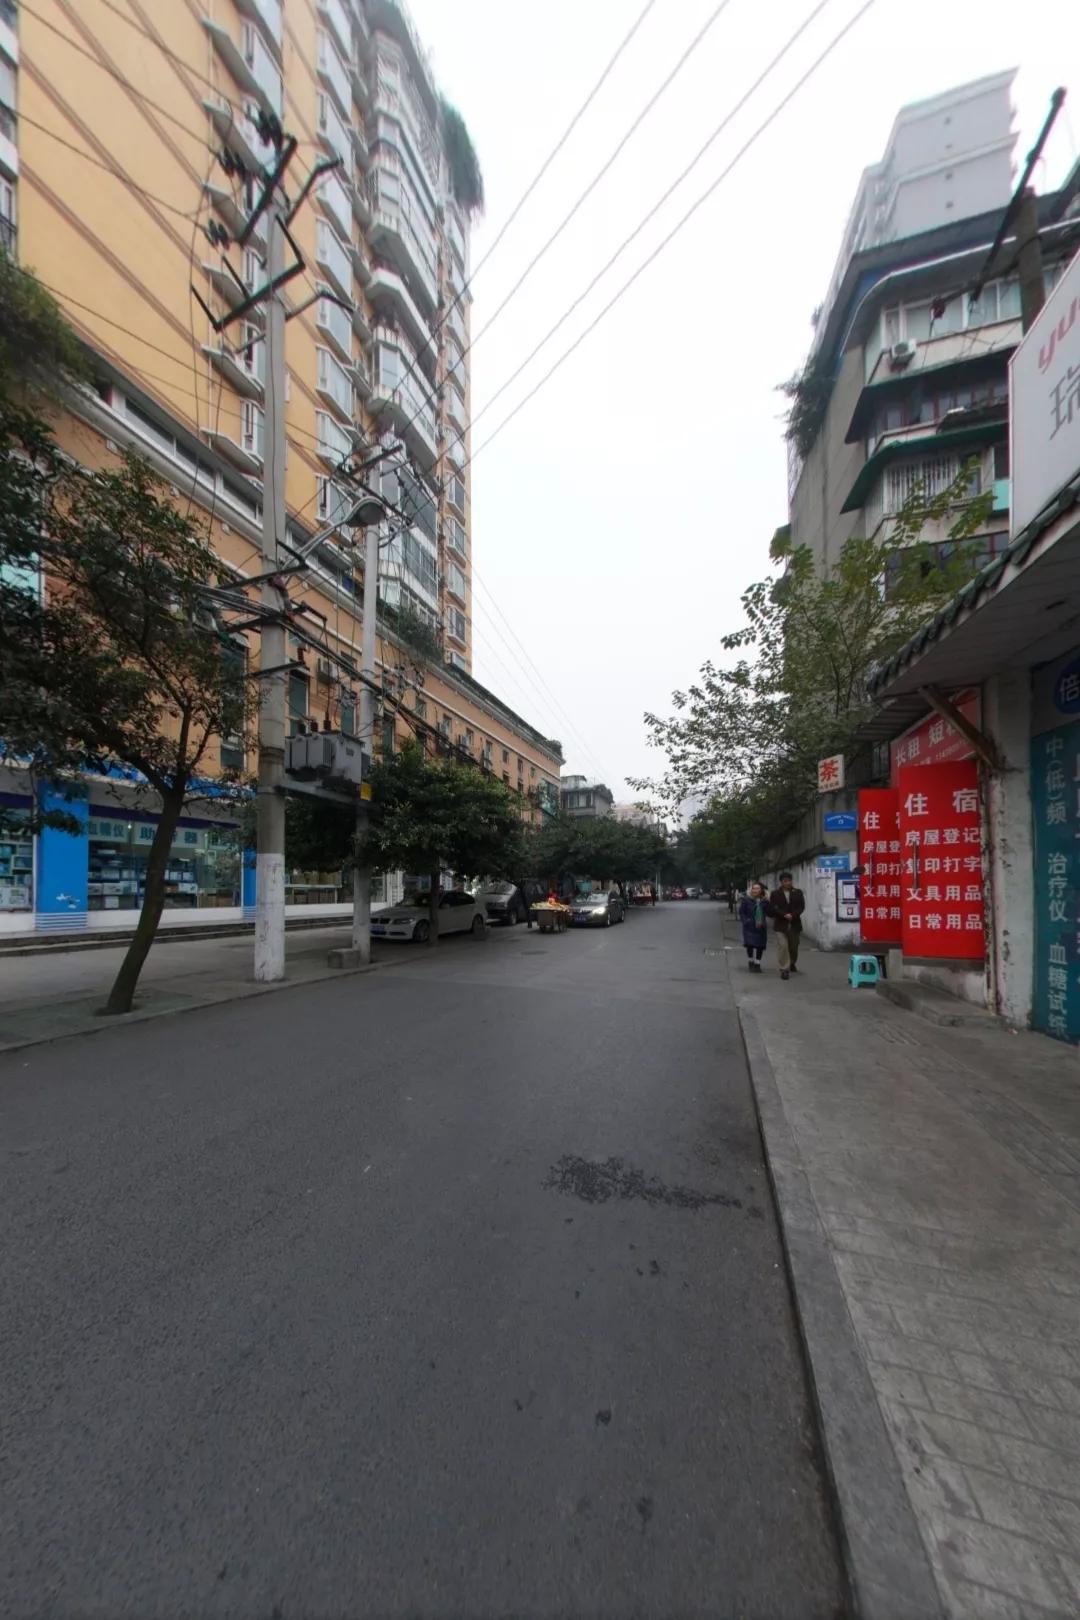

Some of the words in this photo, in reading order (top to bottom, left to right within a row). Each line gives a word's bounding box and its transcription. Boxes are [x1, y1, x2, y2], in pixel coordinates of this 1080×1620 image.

[819, 760, 839, 783] 茶
[904, 788, 978, 817] 住宿
[905, 827, 980, 847] 房屋登记
[905, 856, 981, 874] 复印打字
[906, 885, 982, 901] 文具用品
[1048, 852, 1068, 922] 治疗仪
[909, 913, 983, 930] 日常用品
[1048, 942, 1069, 1039] 血糖试纸
